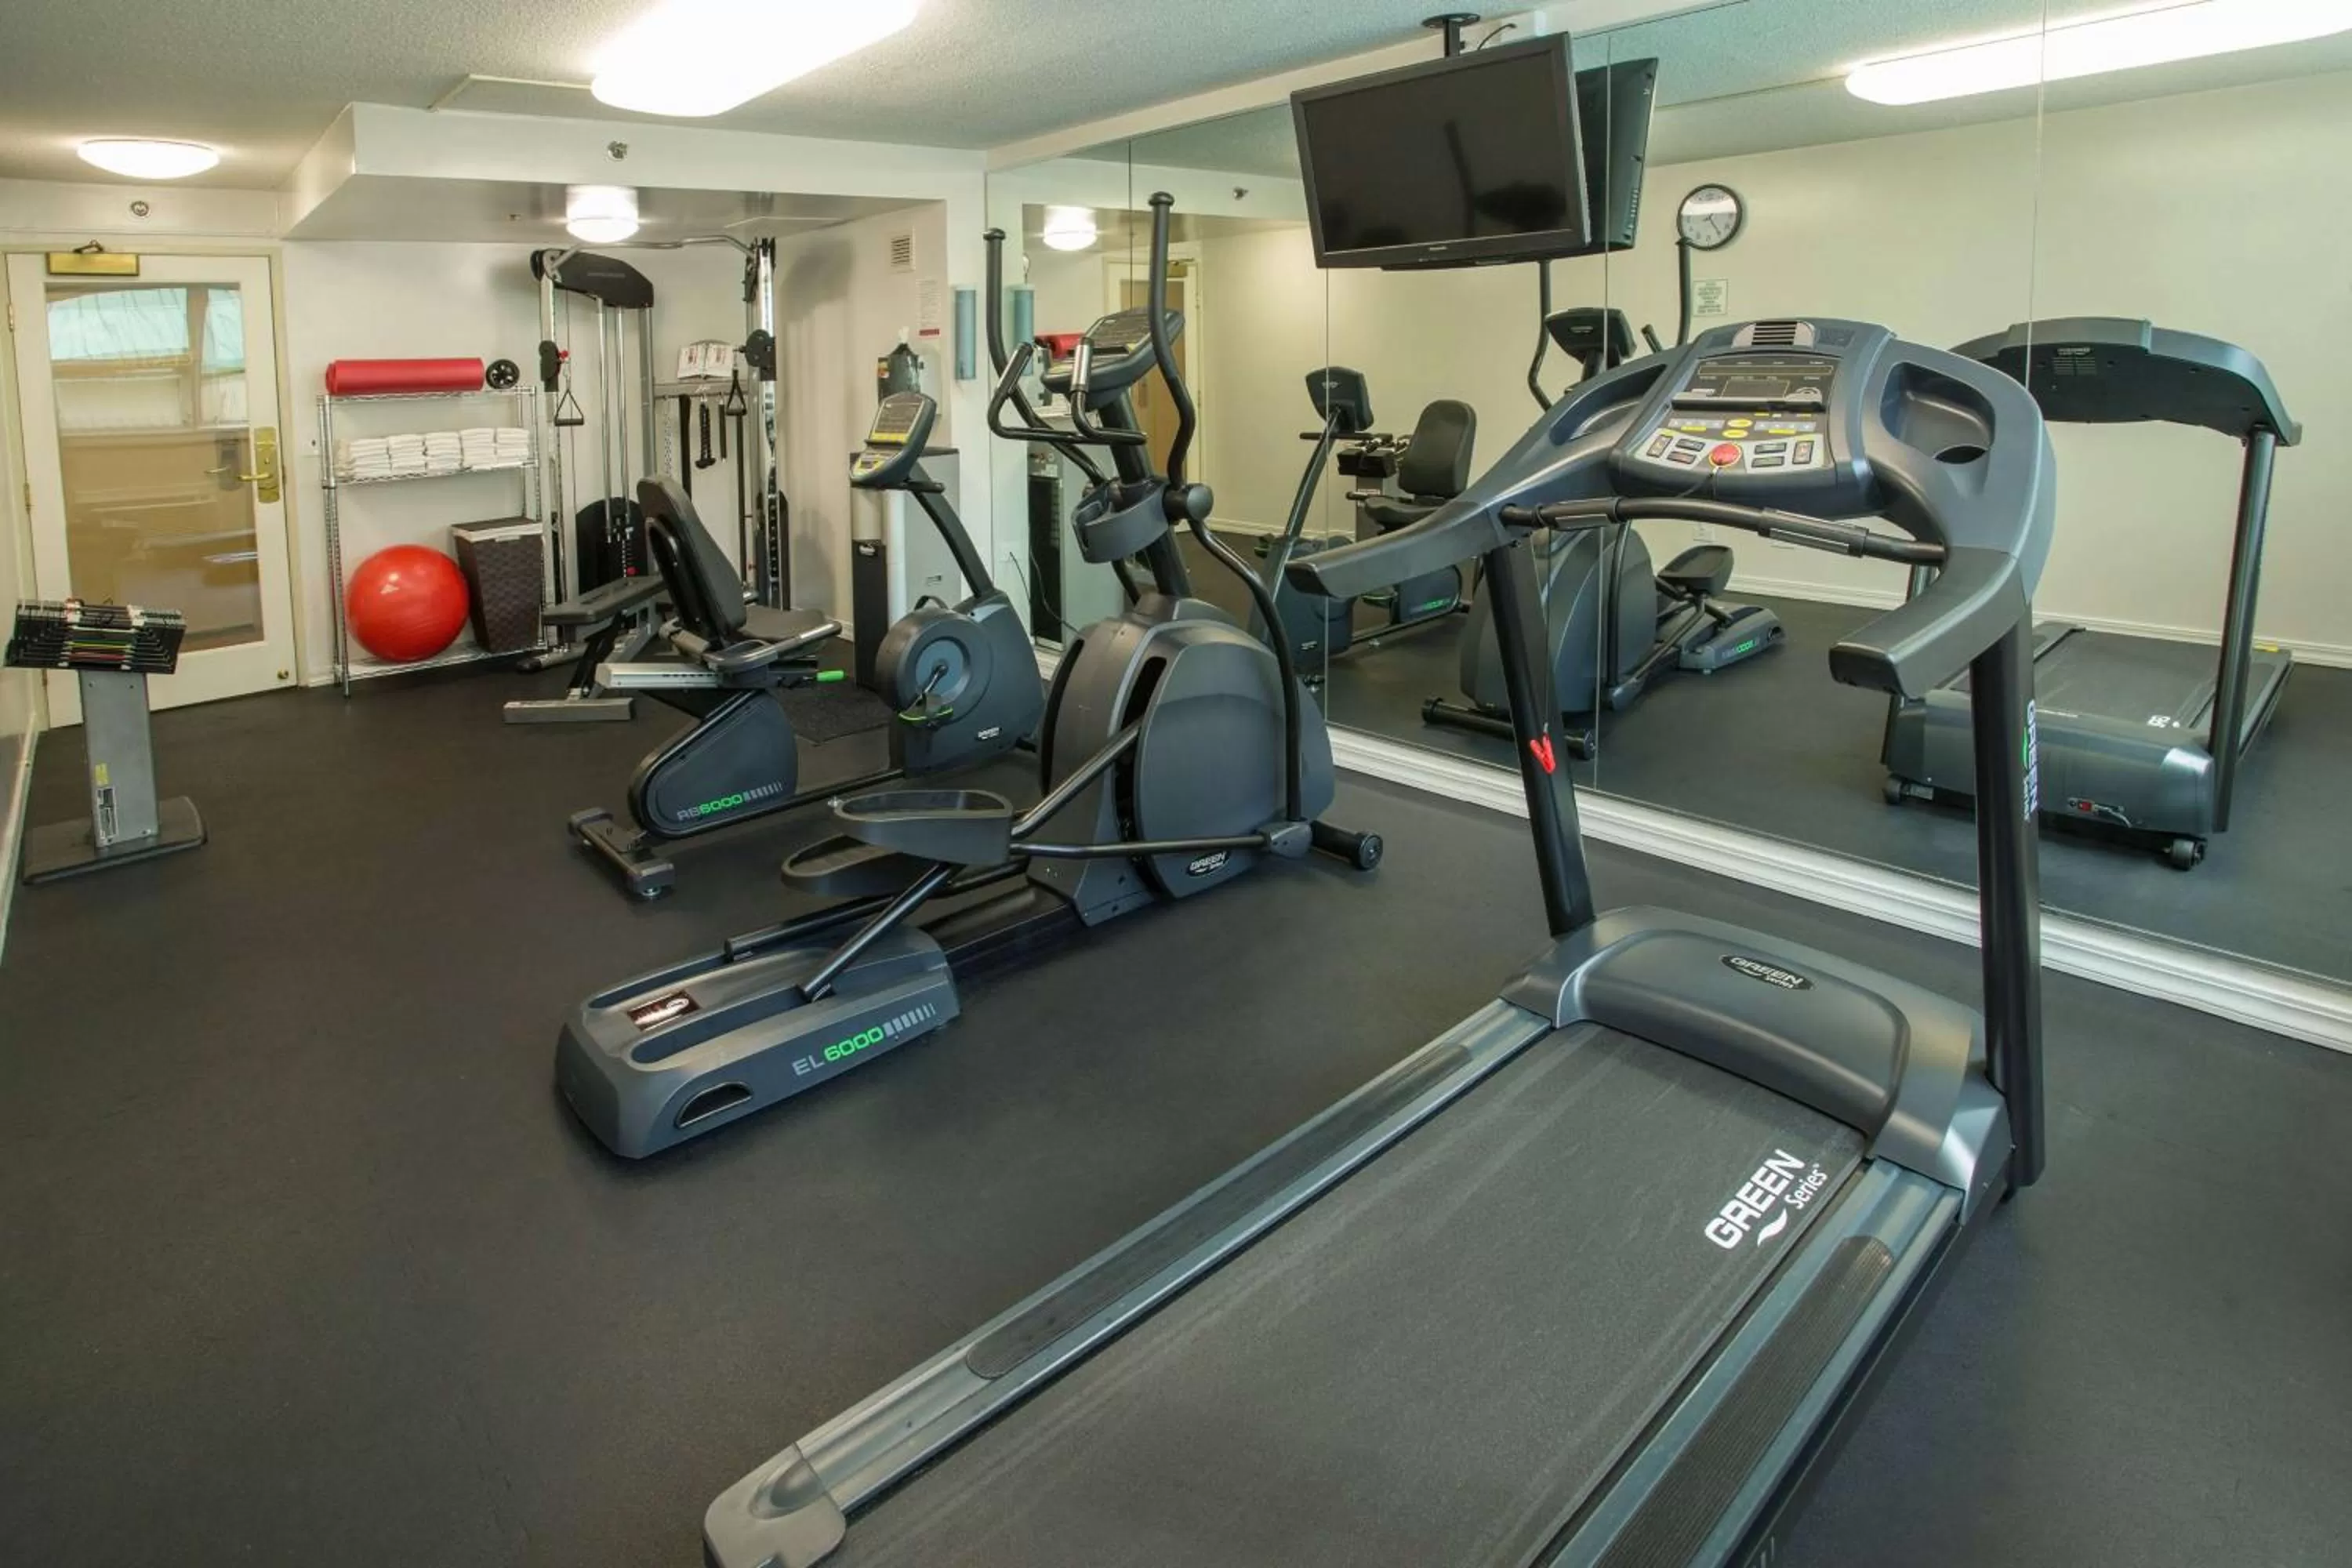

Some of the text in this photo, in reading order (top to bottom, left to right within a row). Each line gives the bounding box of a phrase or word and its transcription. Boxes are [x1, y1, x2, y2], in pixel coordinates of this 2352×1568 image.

[1731, 957, 1804, 985] GREEN
[792, 1026, 884, 1076] EL6000
[1704, 1148, 1806, 1249] GREEN
[1784, 1169, 1828, 1210] Series
